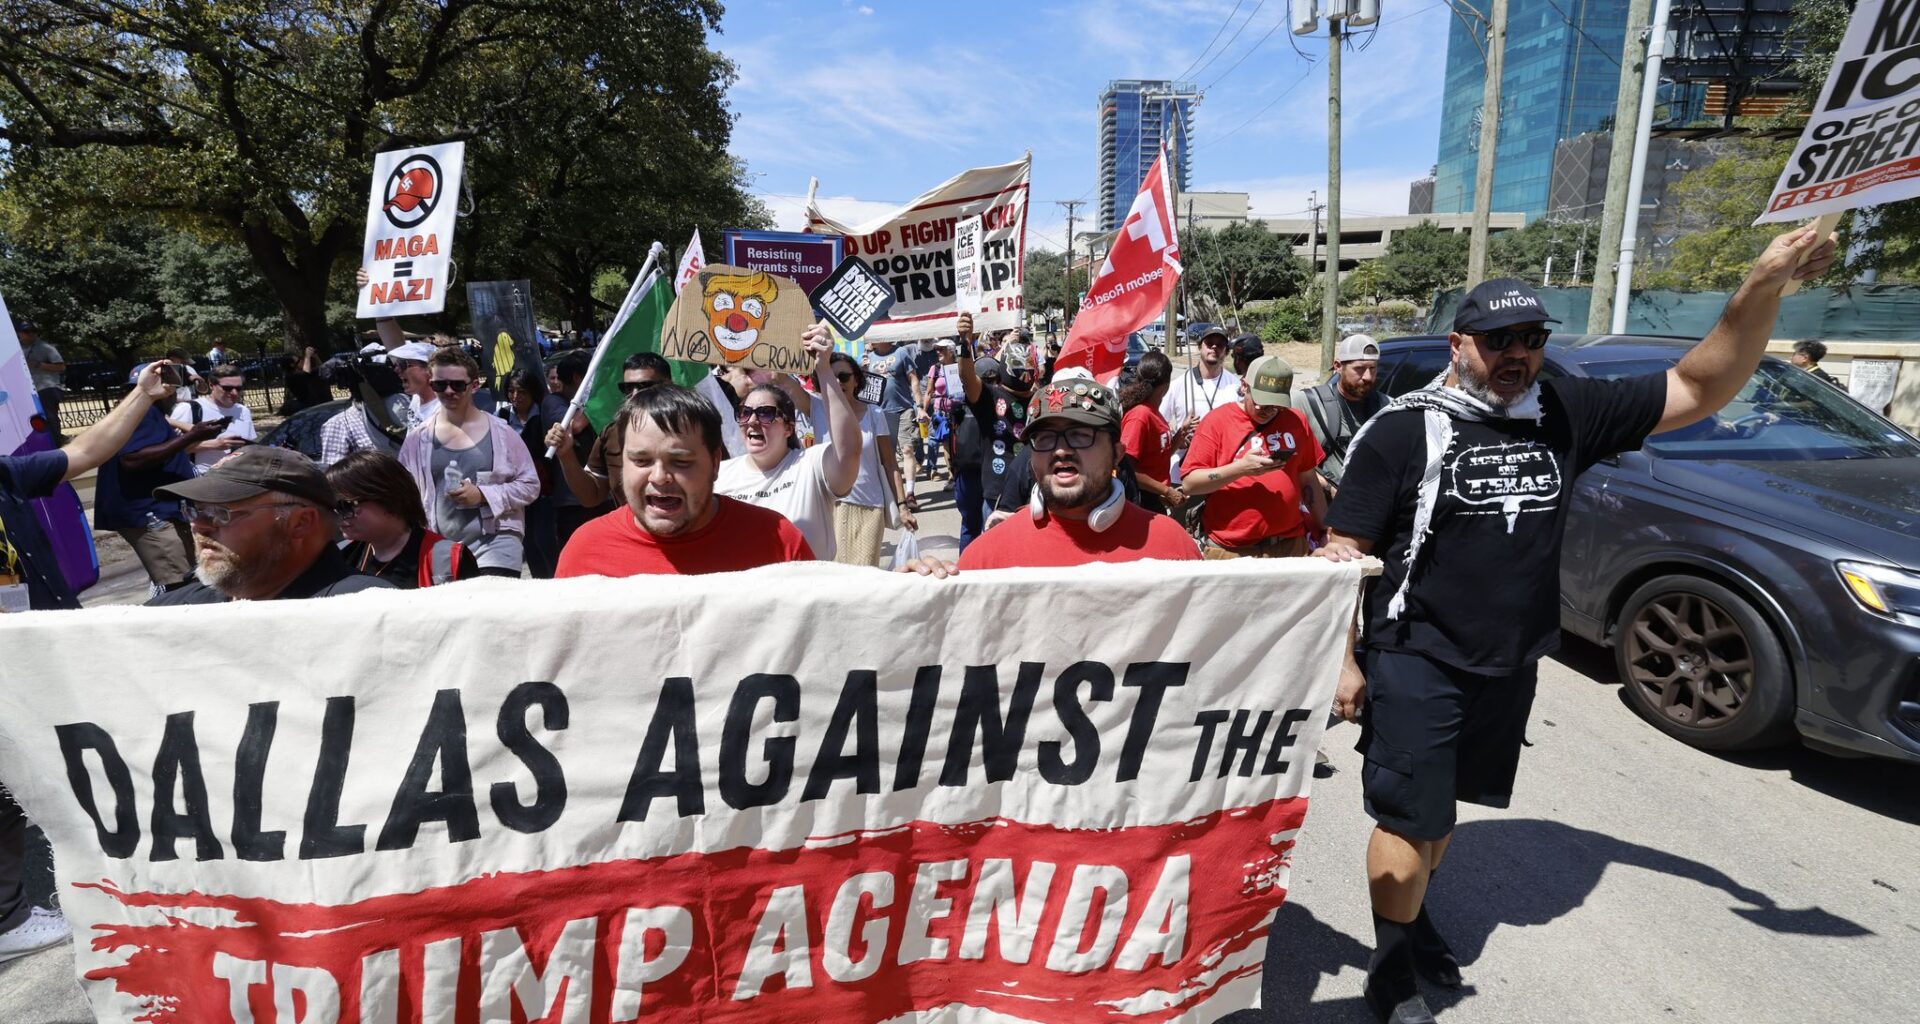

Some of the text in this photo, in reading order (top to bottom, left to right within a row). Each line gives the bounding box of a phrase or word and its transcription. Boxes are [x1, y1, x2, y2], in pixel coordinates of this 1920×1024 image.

[1813, 106, 1896, 141] OFF
[1774, 182, 1847, 211] FRSO
[900, 217, 957, 249] FIGHT
[957, 220, 980, 236] TRUMP'S
[957, 233, 974, 250] ICE
[374, 233, 438, 260] MAGA
[747, 247, 802, 262] Resisting
[873, 238, 1016, 275] DOWN ITH
[957, 246, 975, 261] KILLED
[747, 262, 823, 274] tyrants since
[370, 278, 433, 305] NAZI
[833, 277, 876, 320] VOTERS
[1490, 296, 1537, 310] UNION
[820, 289, 865, 332] MATTER
[751, 342, 810, 370] CROWN
[1469, 452, 1542, 467] ICE OUT
[1498, 465, 1519, 475] OF
[1465, 473, 1554, 495] TEXAS
[54, 661, 1312, 862] DALLAS AGAINST THE
[212, 853, 1192, 1024] TRUMP AGENDA
